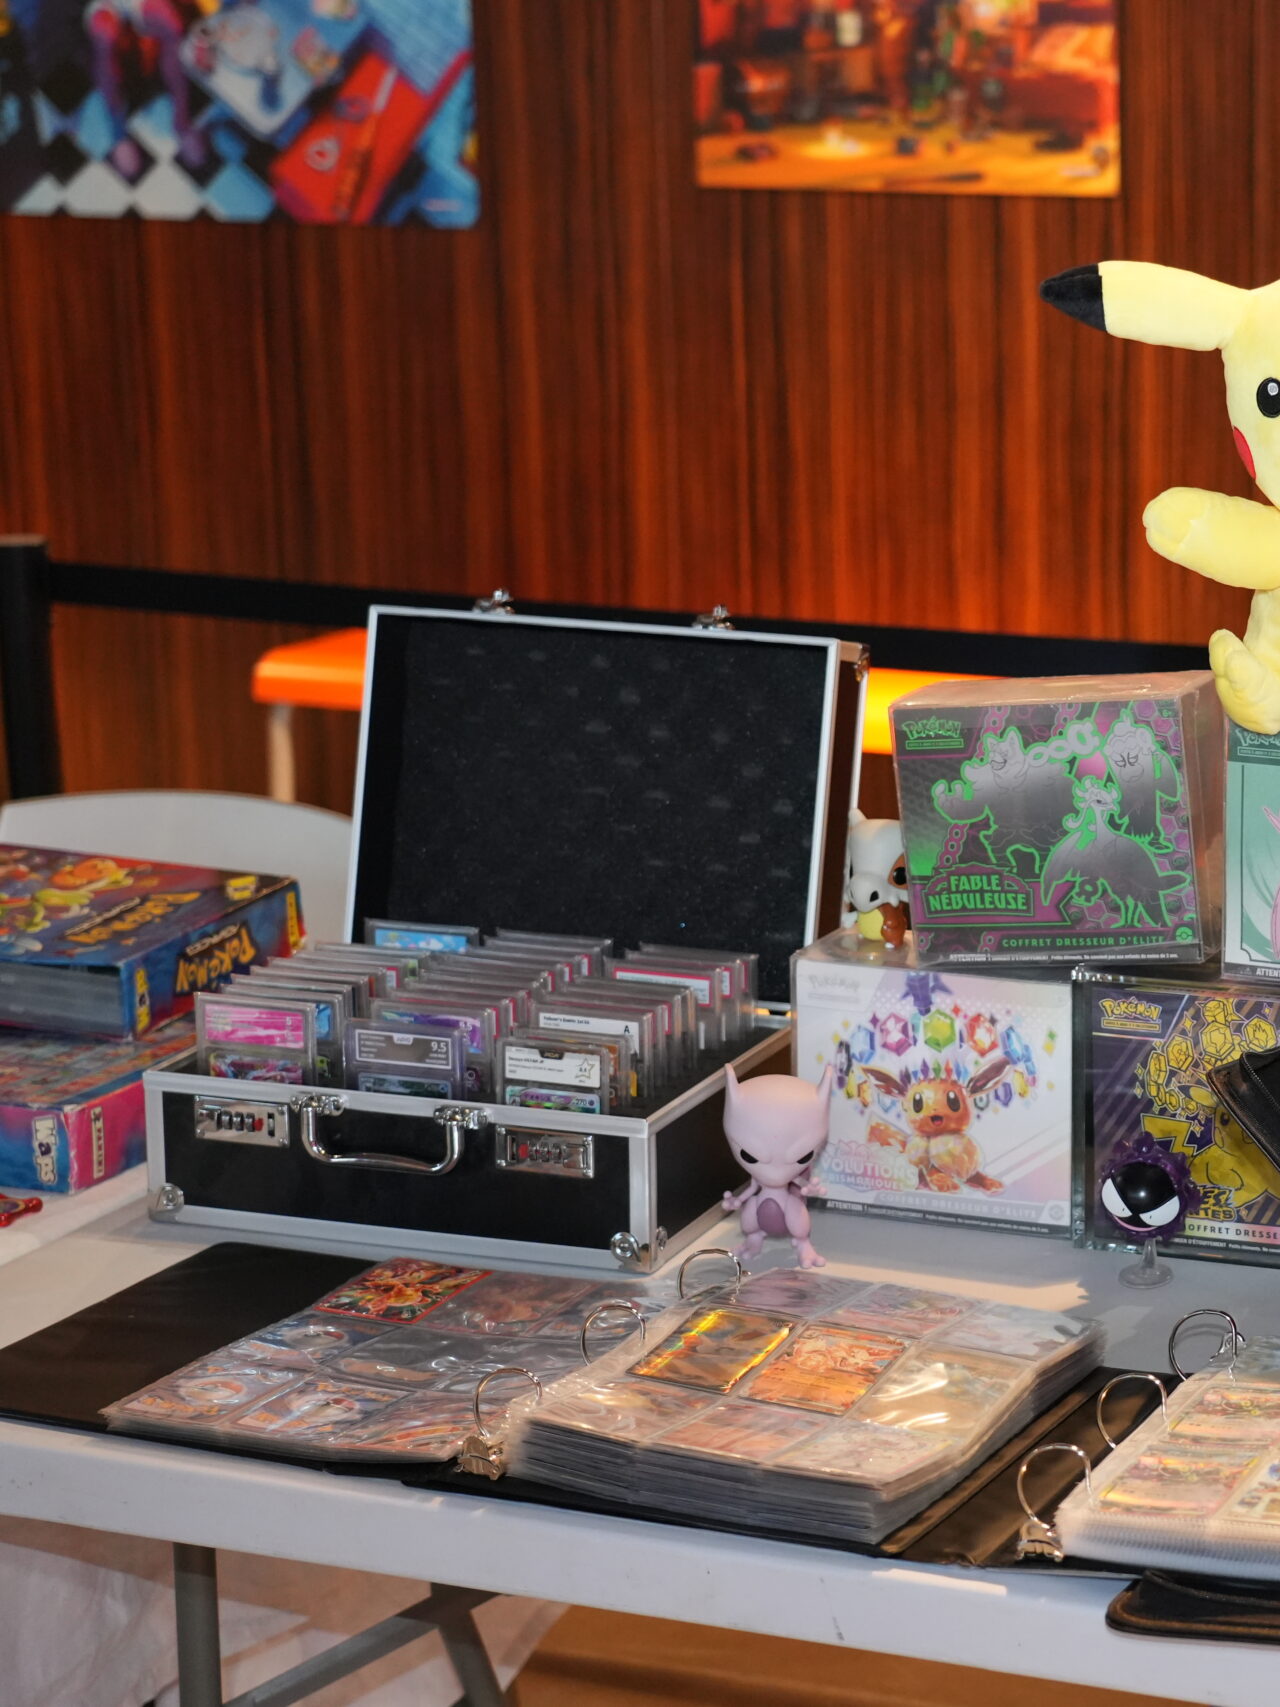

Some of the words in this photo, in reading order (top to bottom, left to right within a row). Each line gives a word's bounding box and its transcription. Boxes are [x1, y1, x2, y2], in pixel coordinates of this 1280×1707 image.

[949, 874, 1002, 891] FABLE
[927, 890, 1028, 912] NÉBULEUSE
[1002, 938, 1051, 947] COFFRET
[1056, 936, 1115, 946] DRESSEUR
[431, 1041, 447, 1053] 9.5
[822, 1159, 918, 1181] VOLUTIONS
[1188, 1224, 1230, 1234] OFFRET
